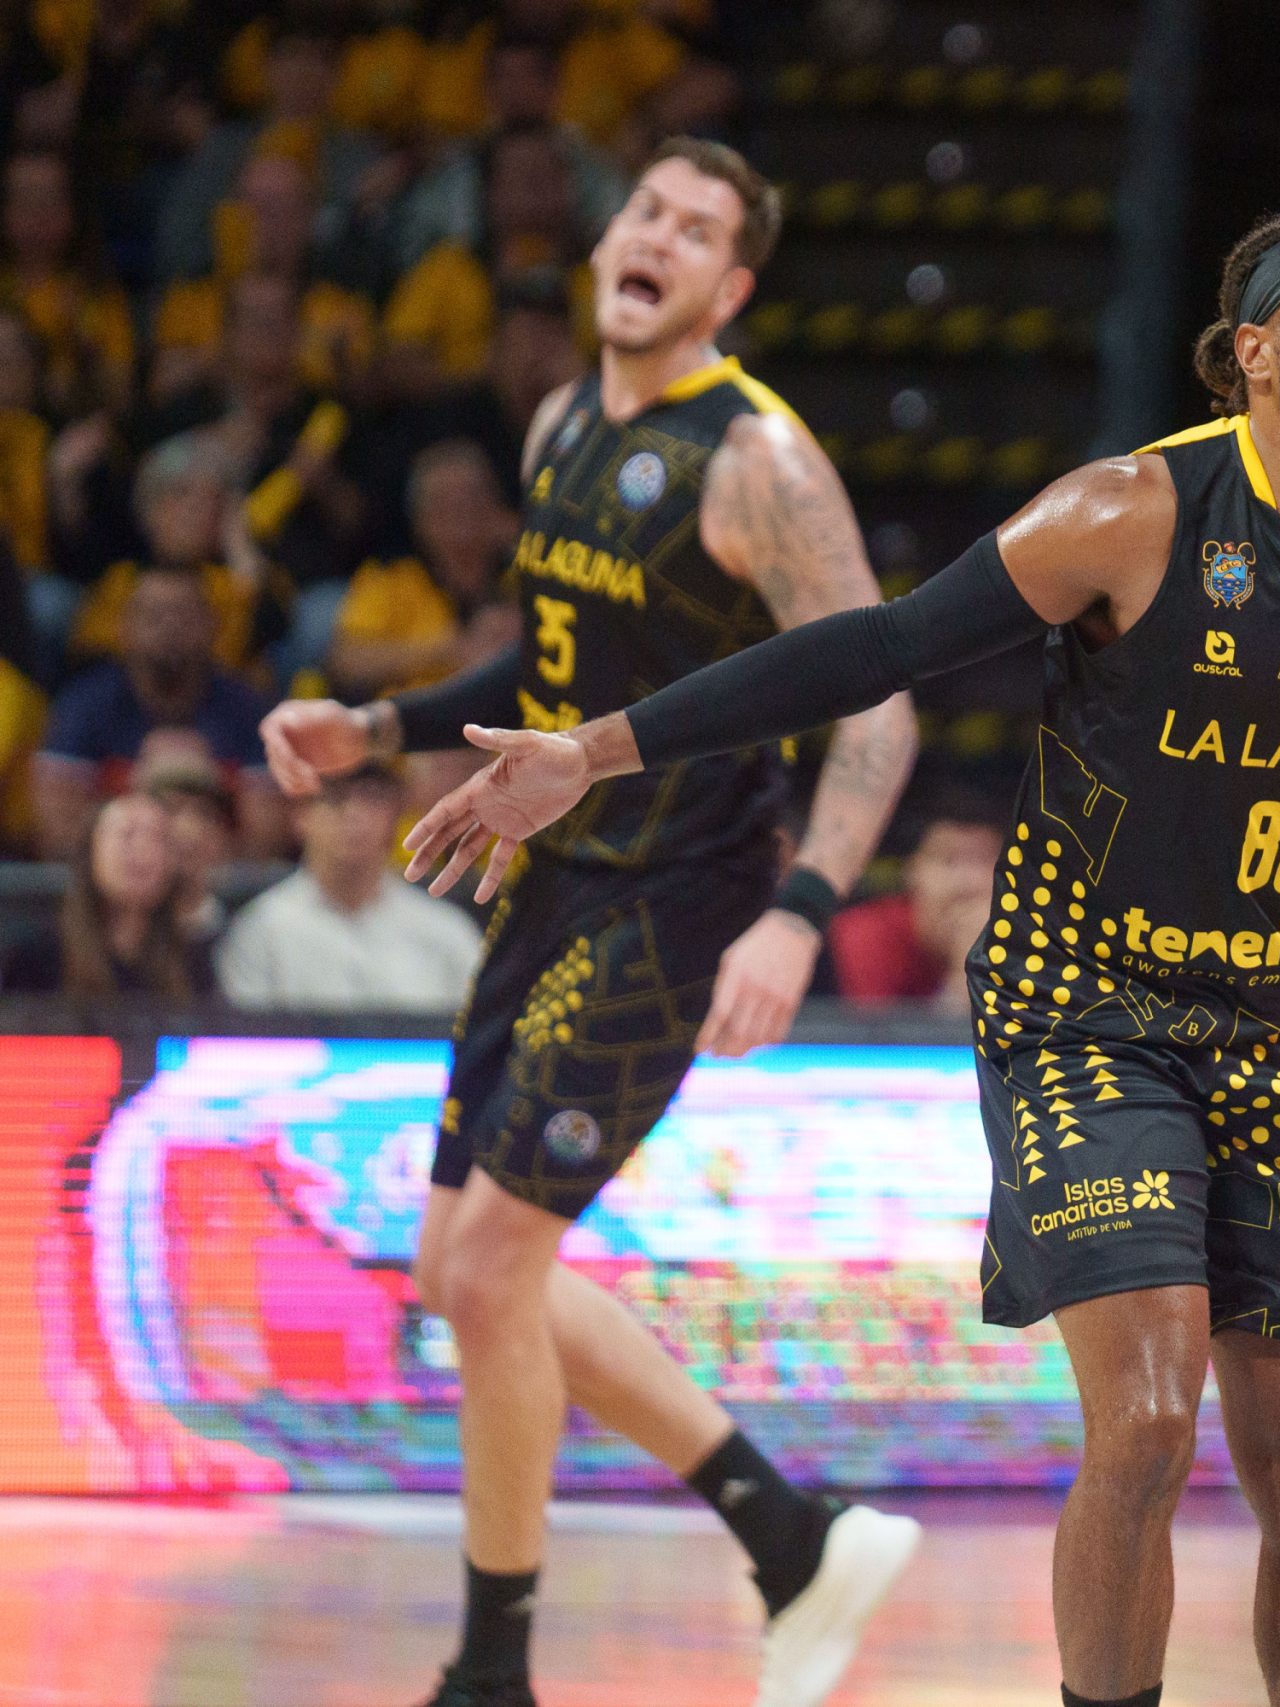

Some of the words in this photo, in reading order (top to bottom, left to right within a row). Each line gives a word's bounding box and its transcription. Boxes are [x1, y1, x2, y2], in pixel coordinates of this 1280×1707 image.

[1193, 663, 1243, 678] austral
[1158, 709, 1226, 764] LA
[1187, 1022, 1199, 1037] B
[1064, 1176, 1126, 1203] Islas
[1031, 1196, 1130, 1236] Canarias
[1100, 1223, 1111, 1232] DE
